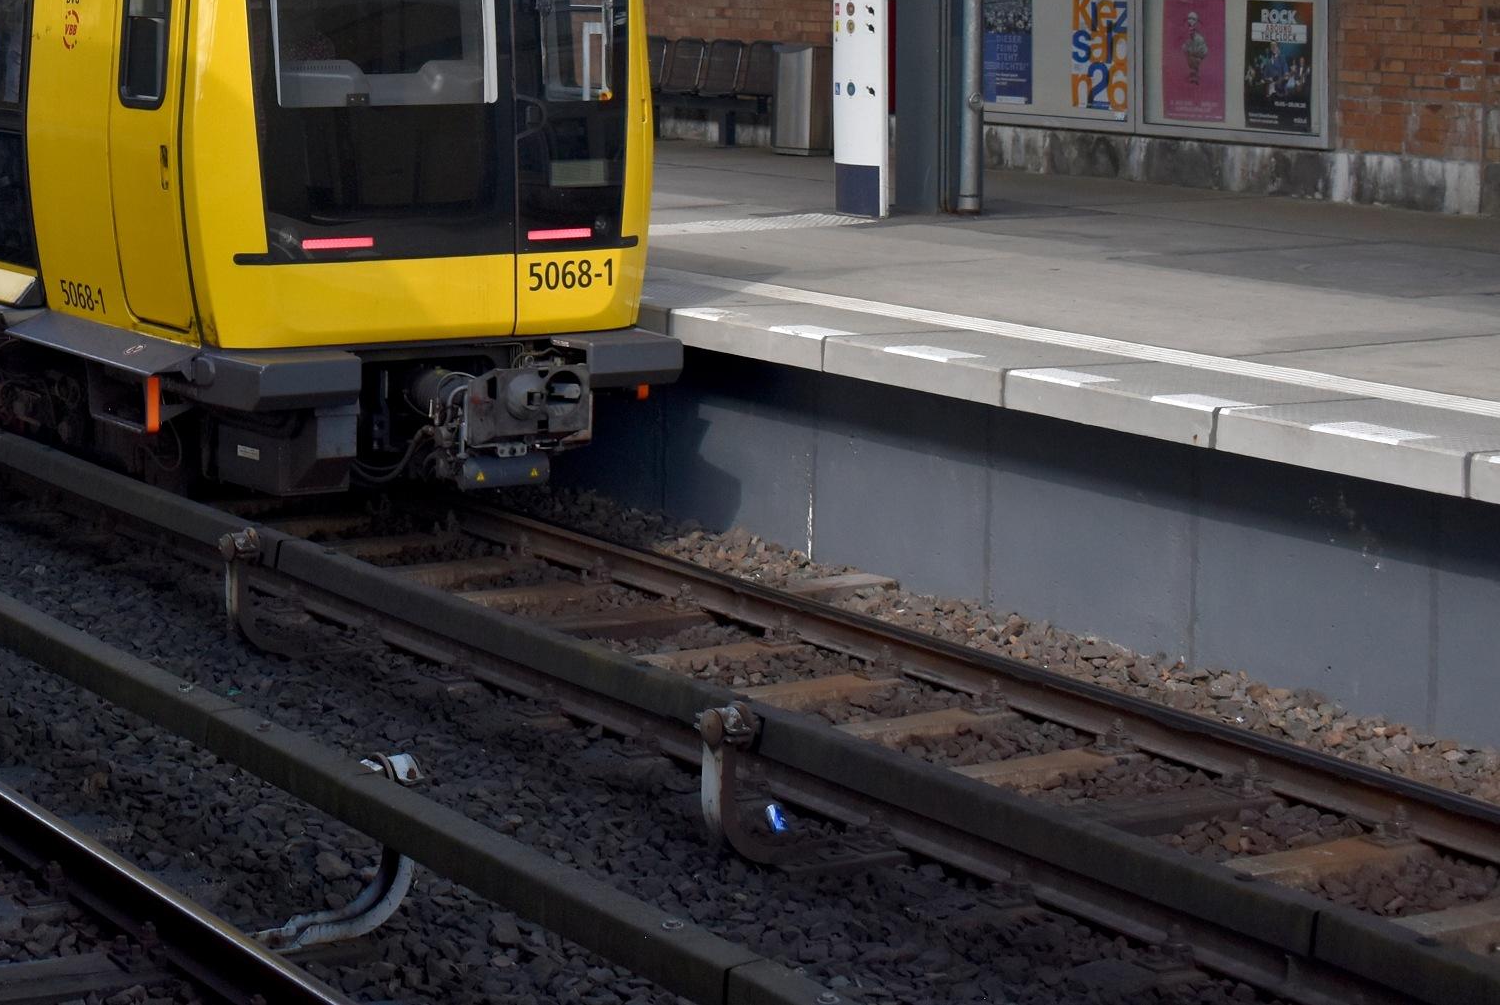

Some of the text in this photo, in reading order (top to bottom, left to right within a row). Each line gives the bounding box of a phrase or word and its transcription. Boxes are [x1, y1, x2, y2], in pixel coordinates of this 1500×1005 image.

[1260, 8, 1298, 25] ROCK
[64, 23, 78, 36] VBB
[1265, 24, 1293, 33] AROUND
[996, 34, 1023, 44] DIESER
[1261, 31, 1298, 42] THE CLOCK
[996, 43, 1019, 53] FEIND
[996, 52, 1018, 62] STEHT
[529, 258, 613, 291] 5068-1
[60, 279, 106, 315] 5068-1
